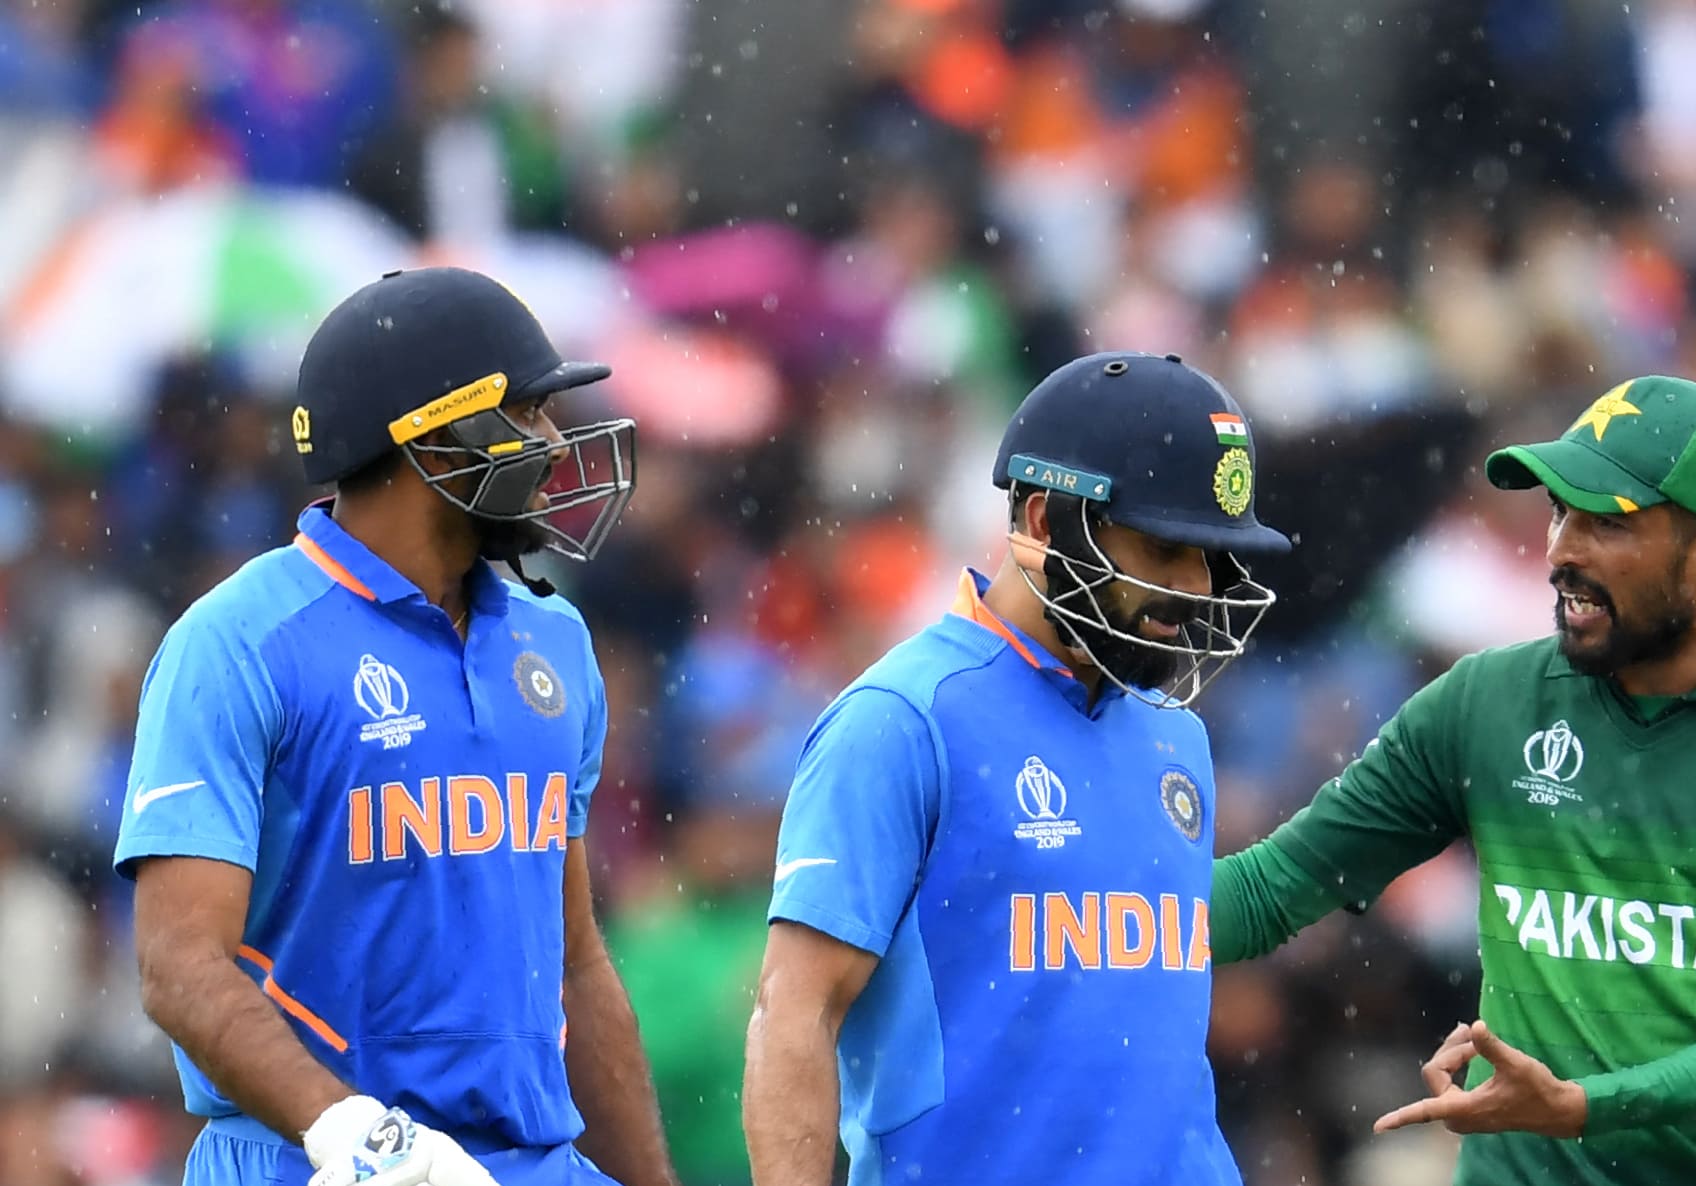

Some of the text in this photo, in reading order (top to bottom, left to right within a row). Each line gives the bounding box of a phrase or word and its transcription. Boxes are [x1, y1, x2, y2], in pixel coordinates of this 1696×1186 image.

[428, 386, 487, 417] MASURI
[1040, 469, 1078, 490] AIR
[382, 732, 411, 750] 2019
[1527, 790, 1560, 806] 2019
[349, 772, 567, 864] INDIA
[1035, 834, 1065, 849] 2019
[1010, 891, 1212, 972] INDIA
